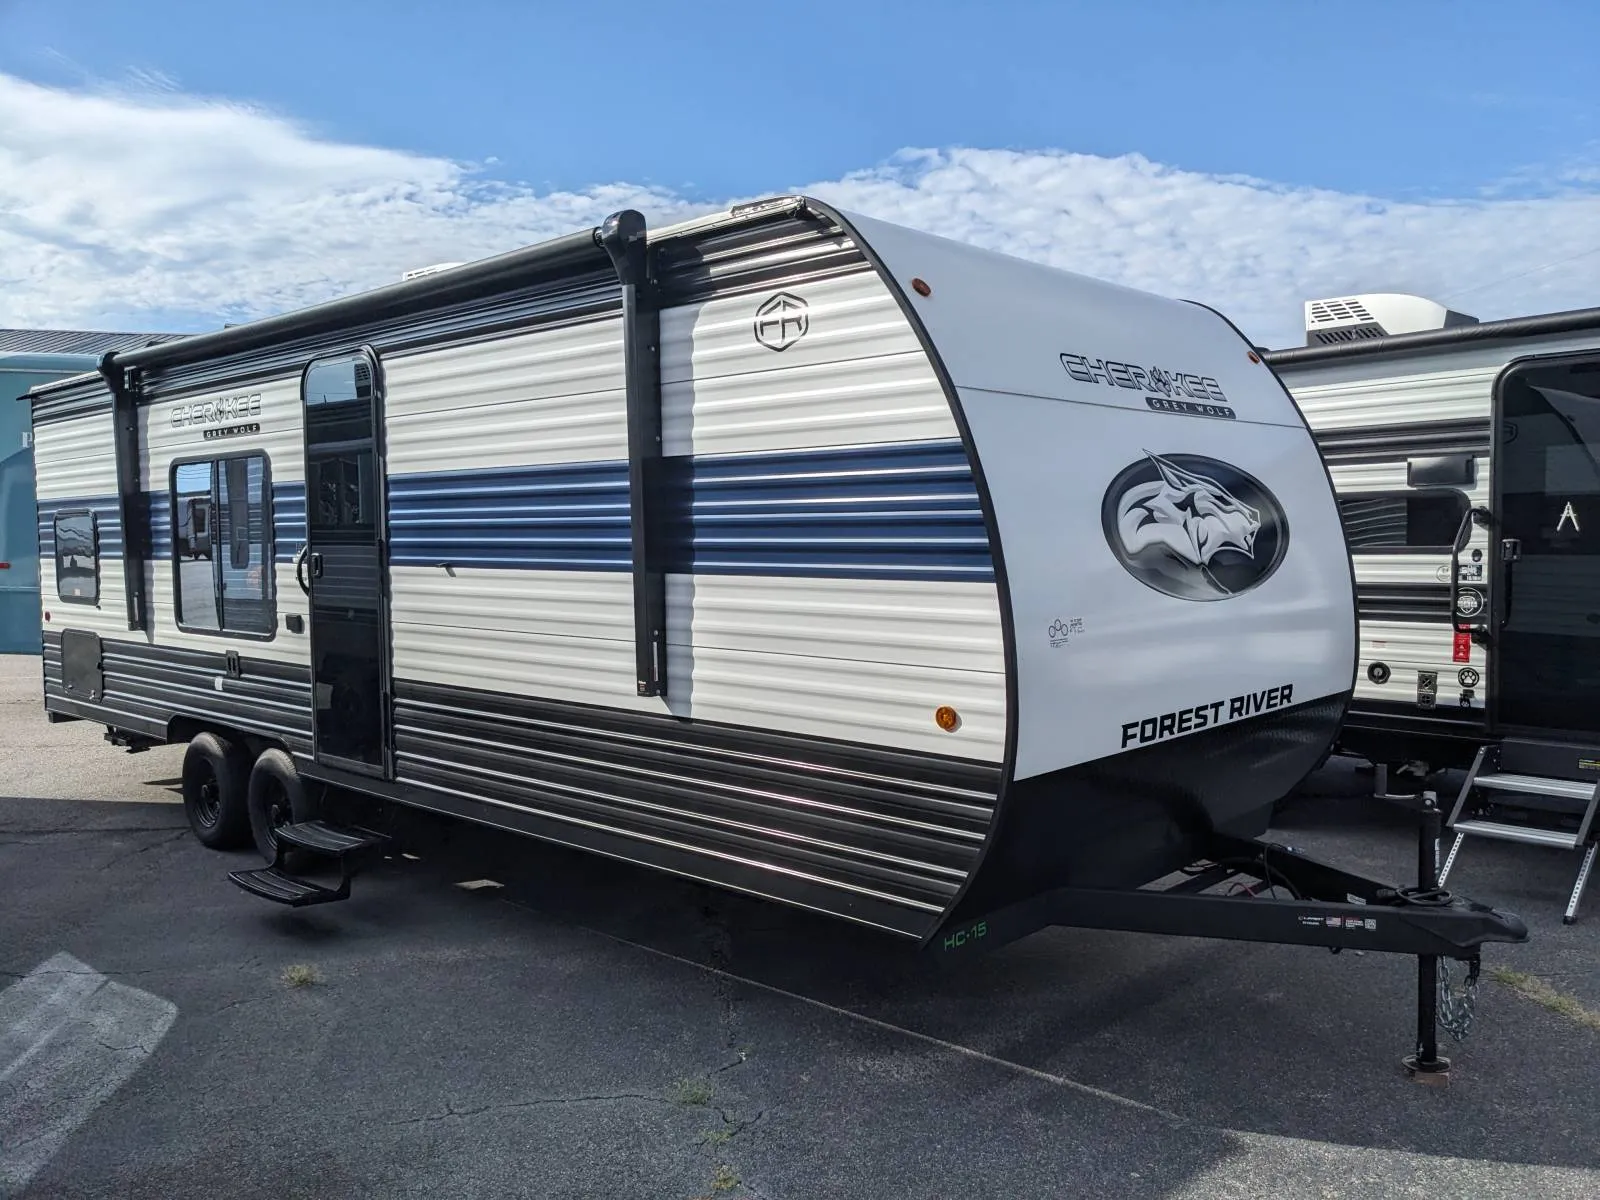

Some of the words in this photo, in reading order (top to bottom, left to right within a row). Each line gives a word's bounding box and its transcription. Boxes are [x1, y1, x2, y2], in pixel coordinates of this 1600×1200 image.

[1060, 352, 1228, 402] CHEROKEE
[171, 393, 262, 428] CHEROKEE
[1152, 399, 1187, 412] GREY
[1196, 405, 1231, 417] WOLF
[206, 428, 228, 438] GREY
[233, 424, 257, 434] WOLF
[1121, 700, 1225, 748] FOREST
[1228, 683, 1293, 720] RIVER
